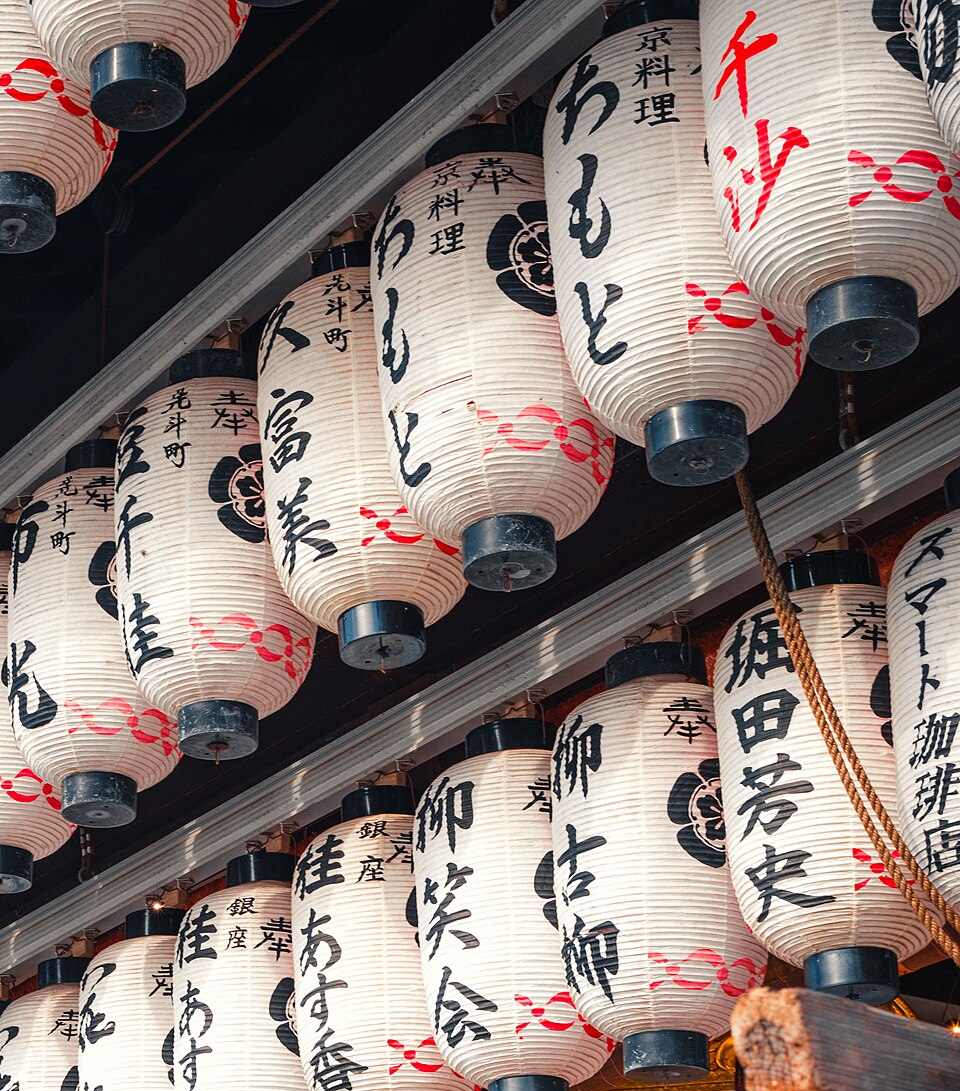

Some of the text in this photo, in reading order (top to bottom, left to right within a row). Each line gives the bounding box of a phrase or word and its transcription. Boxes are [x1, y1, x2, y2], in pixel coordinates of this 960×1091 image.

[632, 27, 680, 127] 京料理
[428, 162, 465, 255] 京料理
[321, 273, 352, 352] 先斗町
[161, 388, 191, 468] 先斗町
[50, 476, 77, 555] 先斗町
[357, 820, 388, 883] 銀座
[227, 897, 258, 950] 銀座
